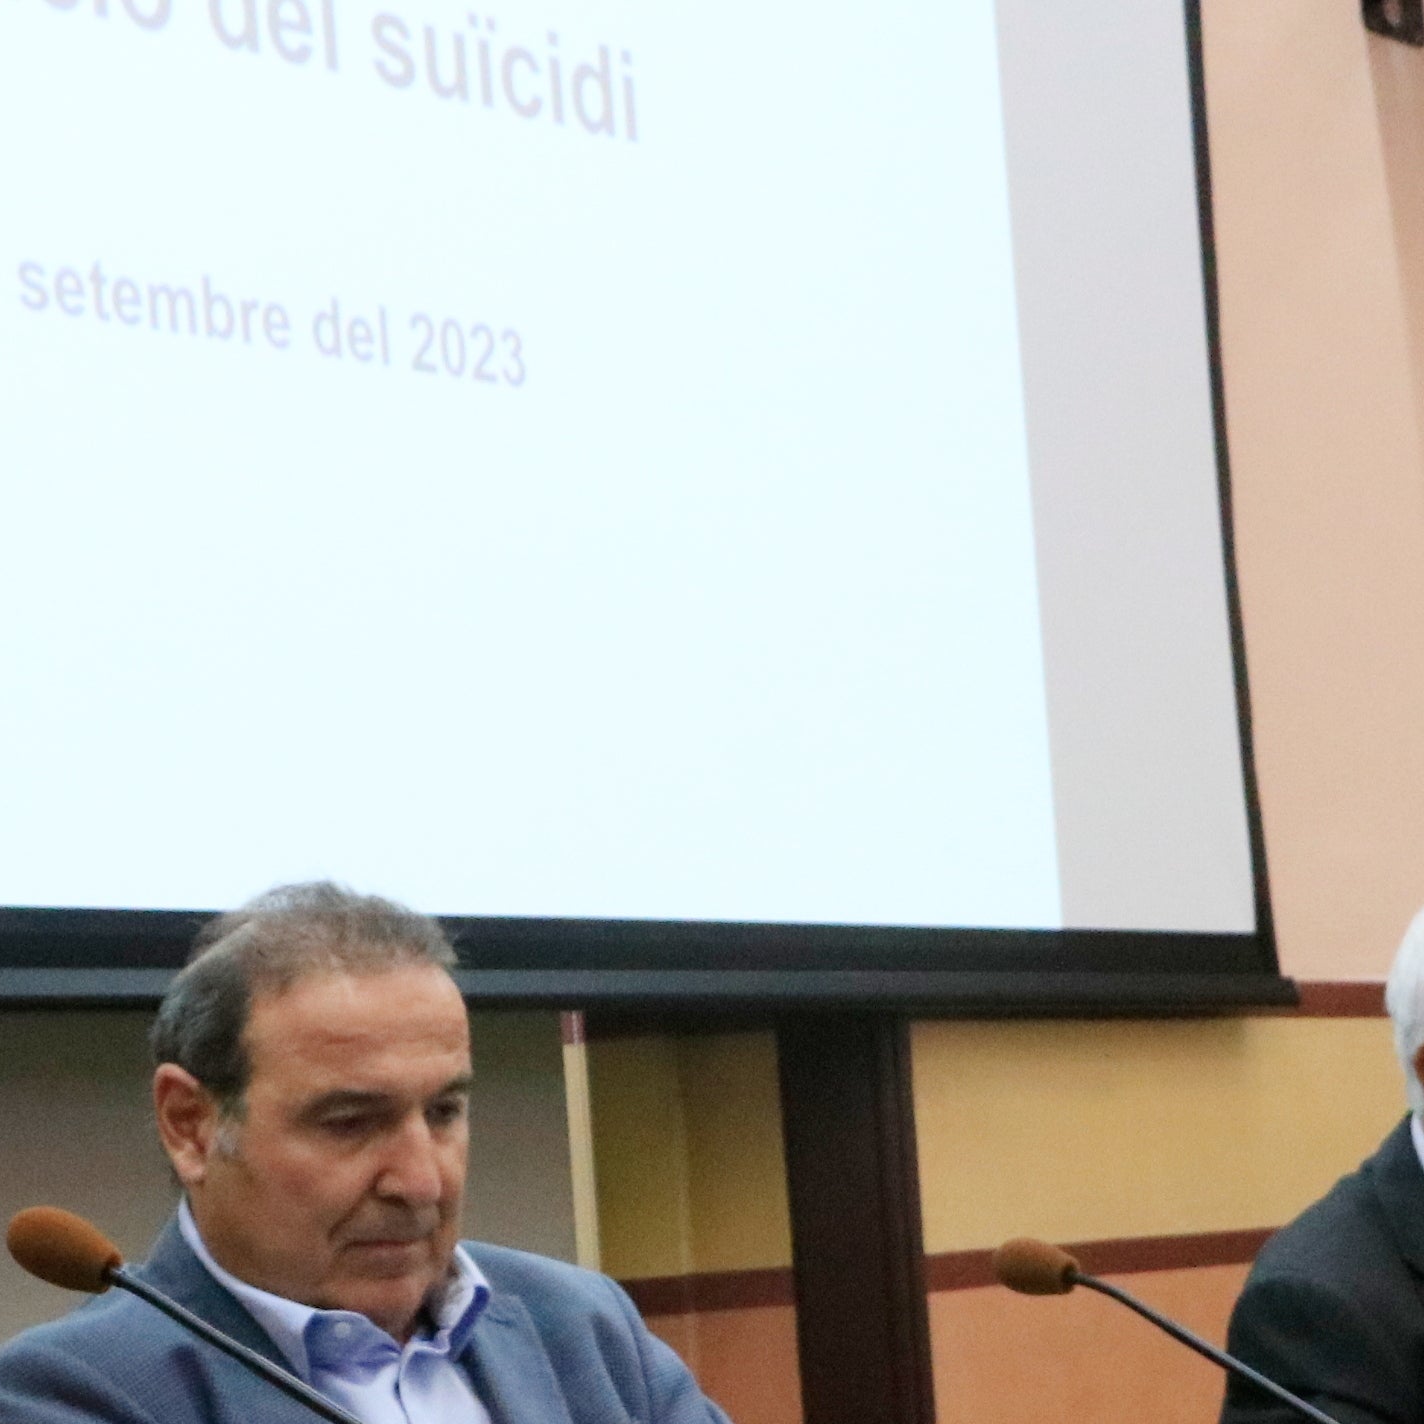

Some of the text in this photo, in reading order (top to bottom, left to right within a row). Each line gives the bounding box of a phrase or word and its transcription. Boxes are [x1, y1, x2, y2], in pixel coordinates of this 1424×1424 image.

[371, 12, 639, 143] suïcidi
[17, 258, 290, 349] setembre
[312, 296, 390, 366] del
[409, 311, 526, 388] 2023
